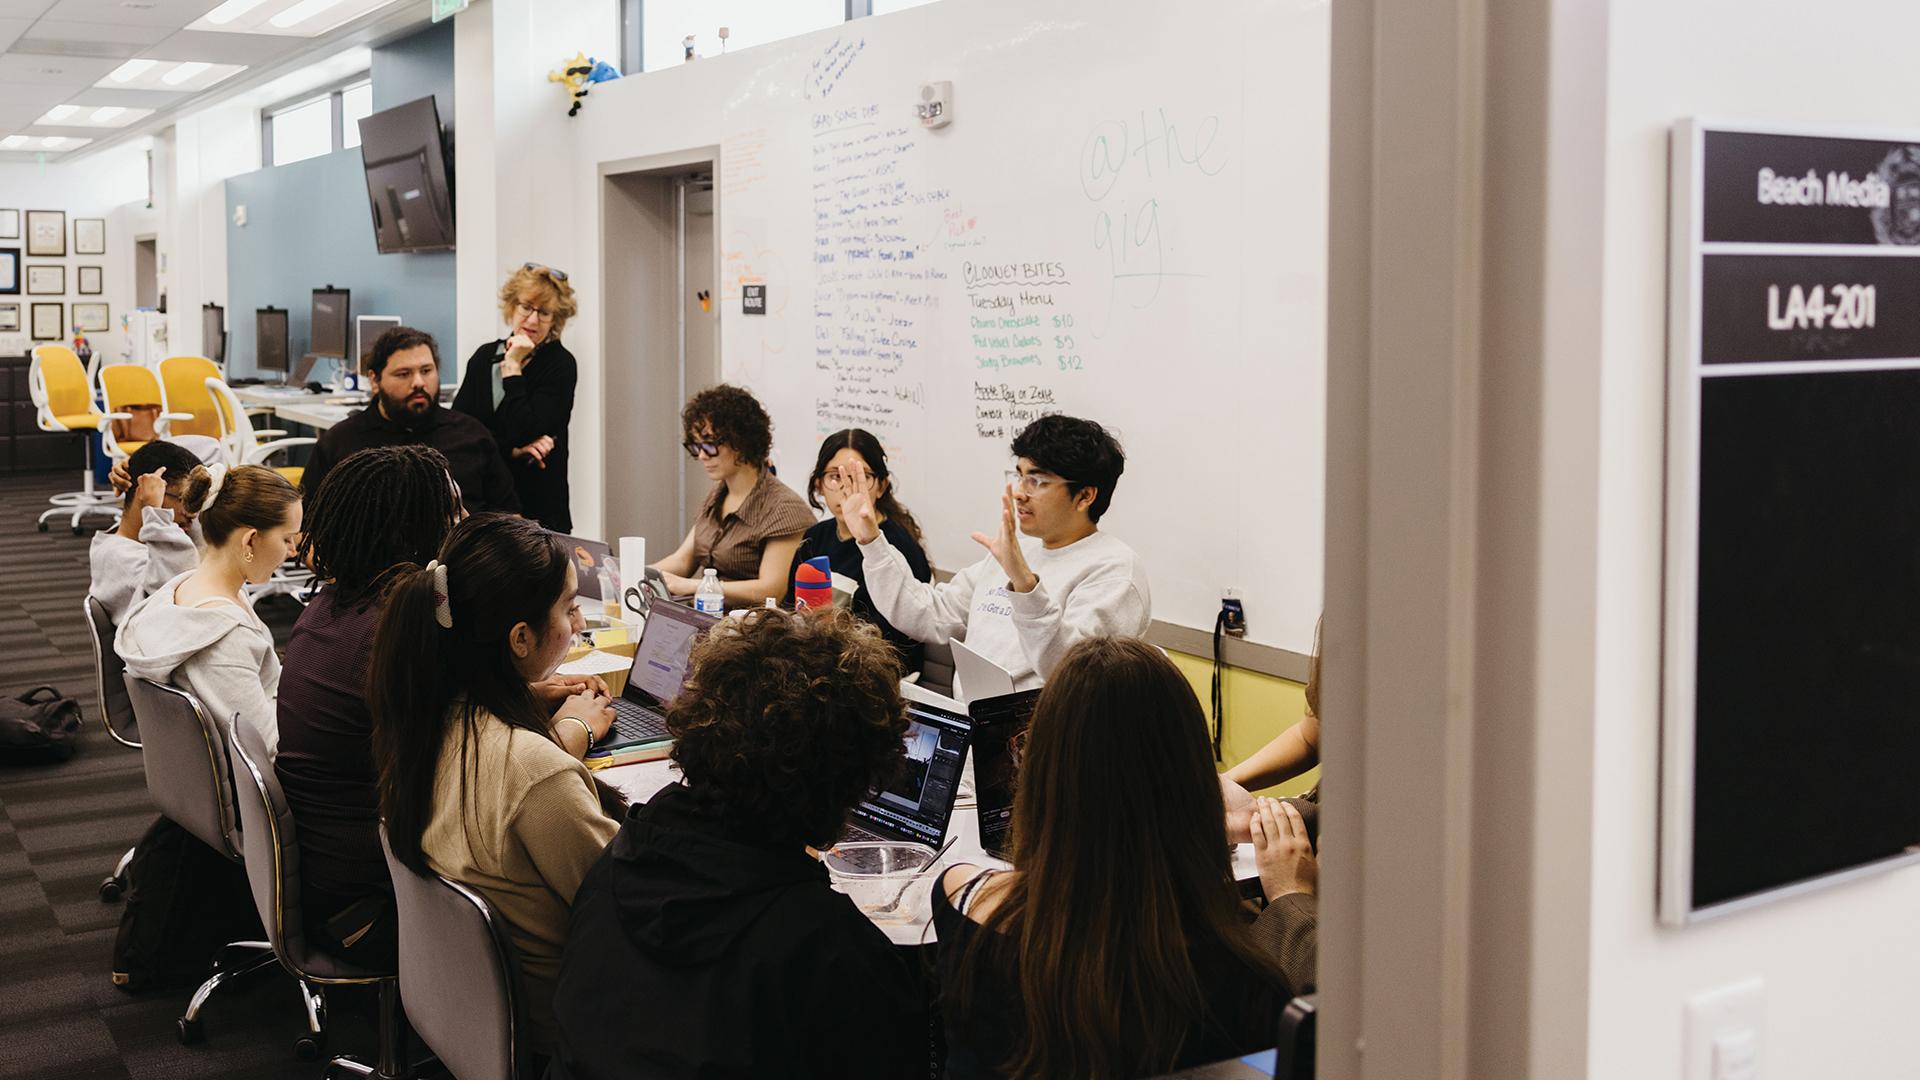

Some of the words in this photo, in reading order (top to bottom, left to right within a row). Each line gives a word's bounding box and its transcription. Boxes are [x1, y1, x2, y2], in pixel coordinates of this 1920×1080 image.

[1757, 166, 1824, 206] Beach
[1825, 171, 1892, 208] Media
[1022, 261, 1066, 280] BITES
[968, 294, 1016, 318] Tuesday
[1019, 290, 1055, 307] Menu
[1767, 283, 1877, 331] LA4-201
[1050, 313, 1075, 329] $10
[1057, 354, 1084, 371] $12
[974, 380, 999, 399] Apple
[999, 383, 1017, 409] Pay
[1017, 388, 1028, 400] or
[975, 405, 1003, 421] Contact
[976, 423, 996, 440] Phone
